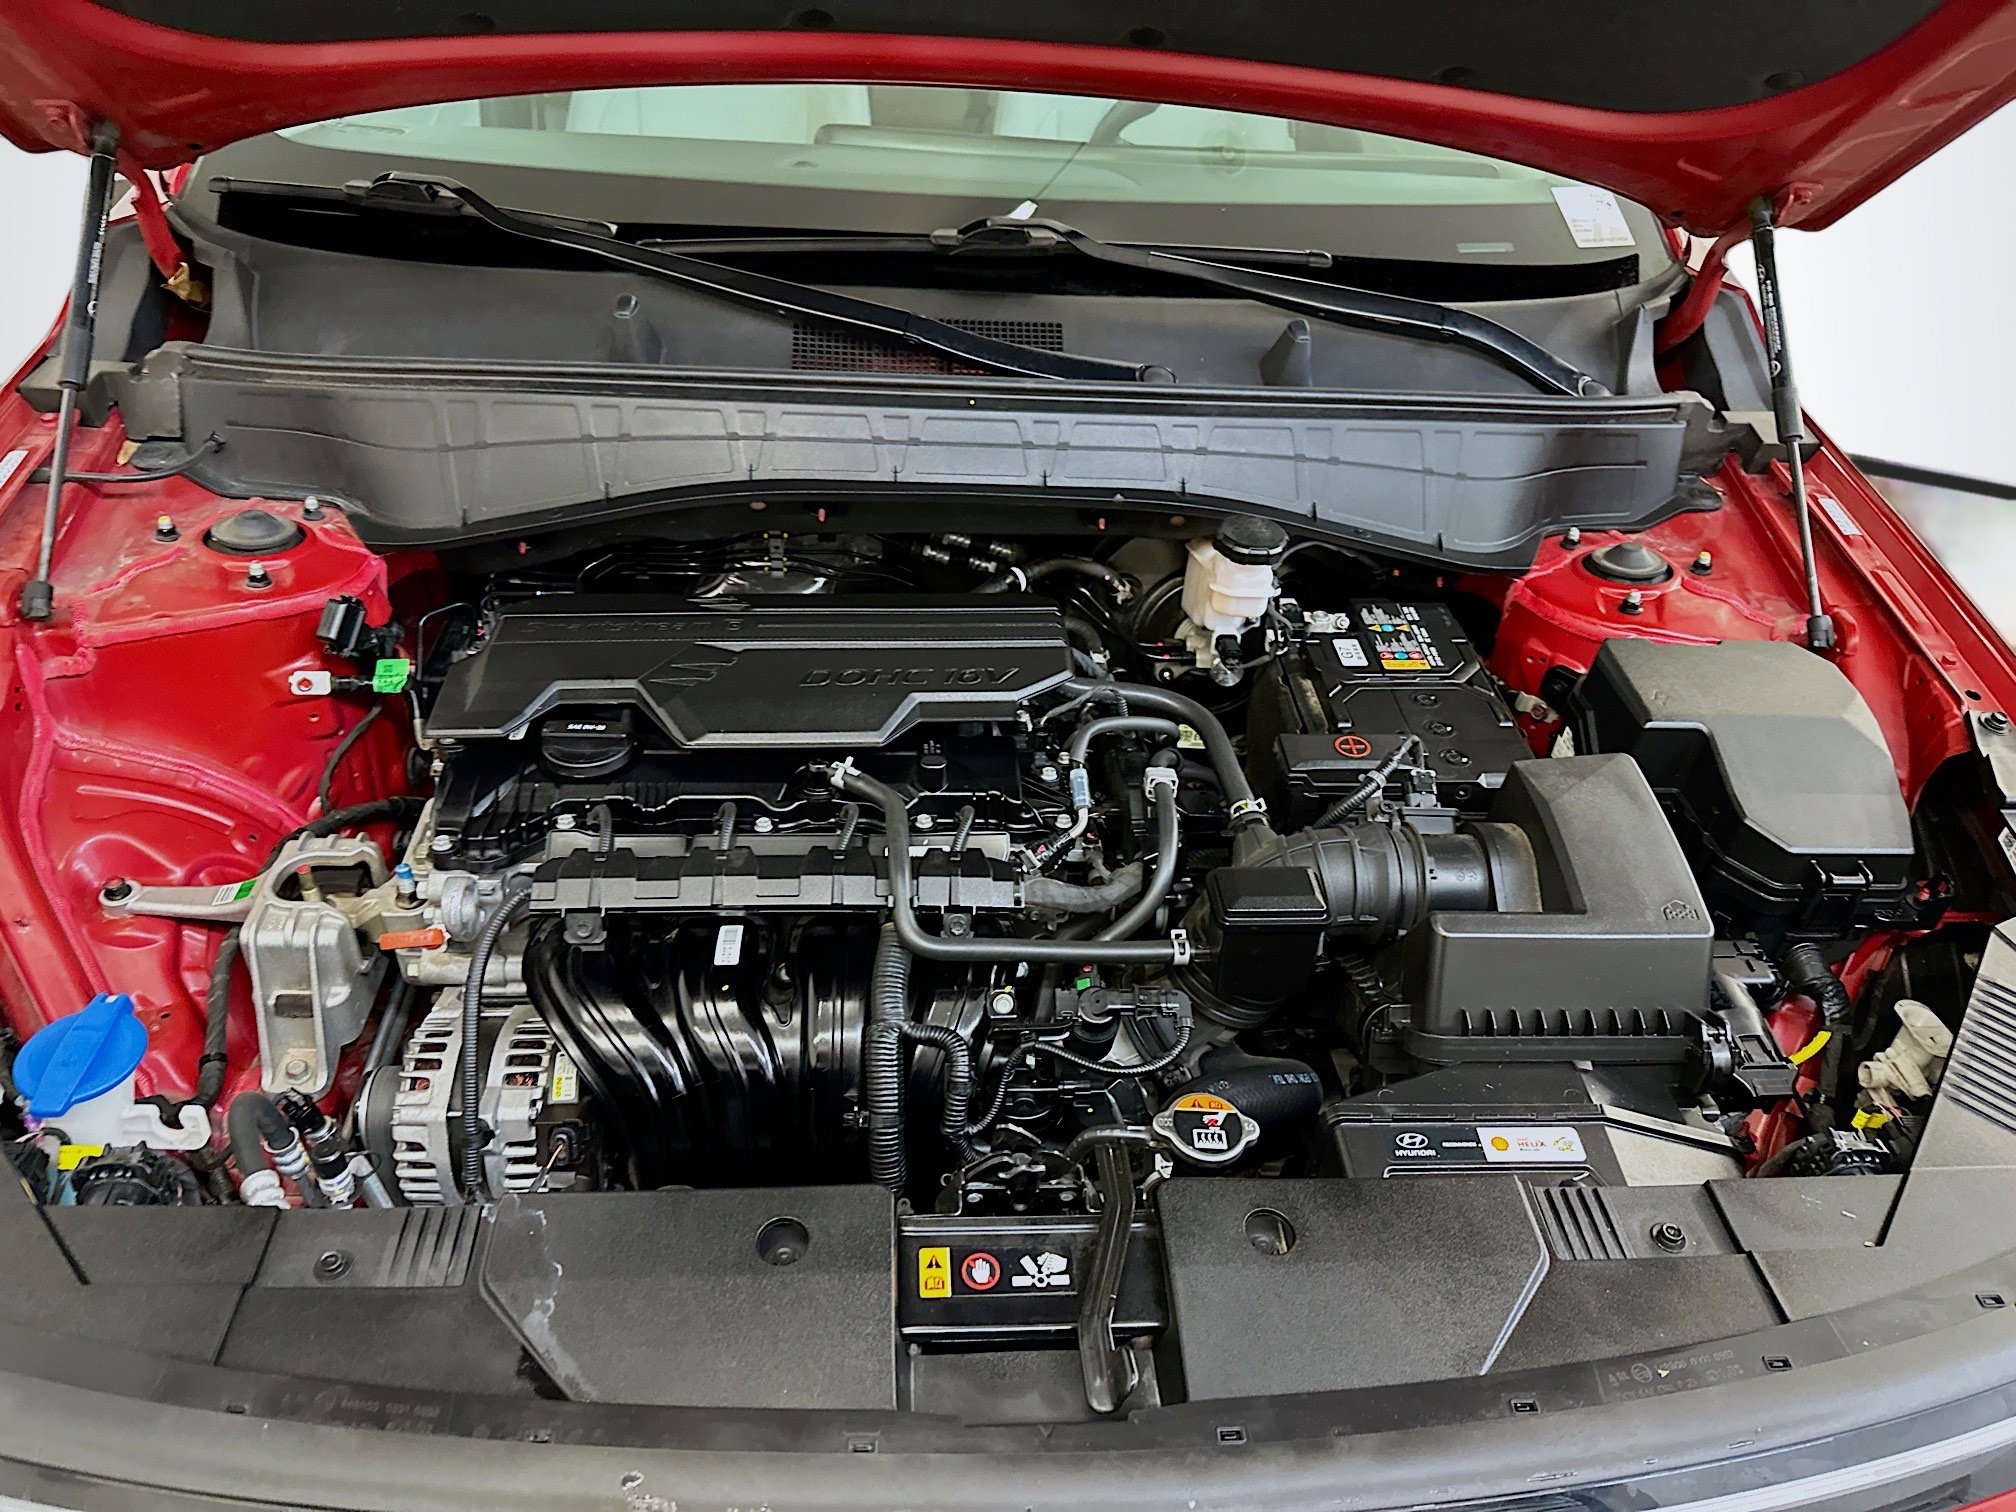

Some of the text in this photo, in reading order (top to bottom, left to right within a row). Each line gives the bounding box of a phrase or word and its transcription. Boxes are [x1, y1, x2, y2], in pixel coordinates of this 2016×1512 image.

[799, 666, 1020, 688] DOHC 16V
[1394, 1149, 1437, 1157] HYUNDAI
